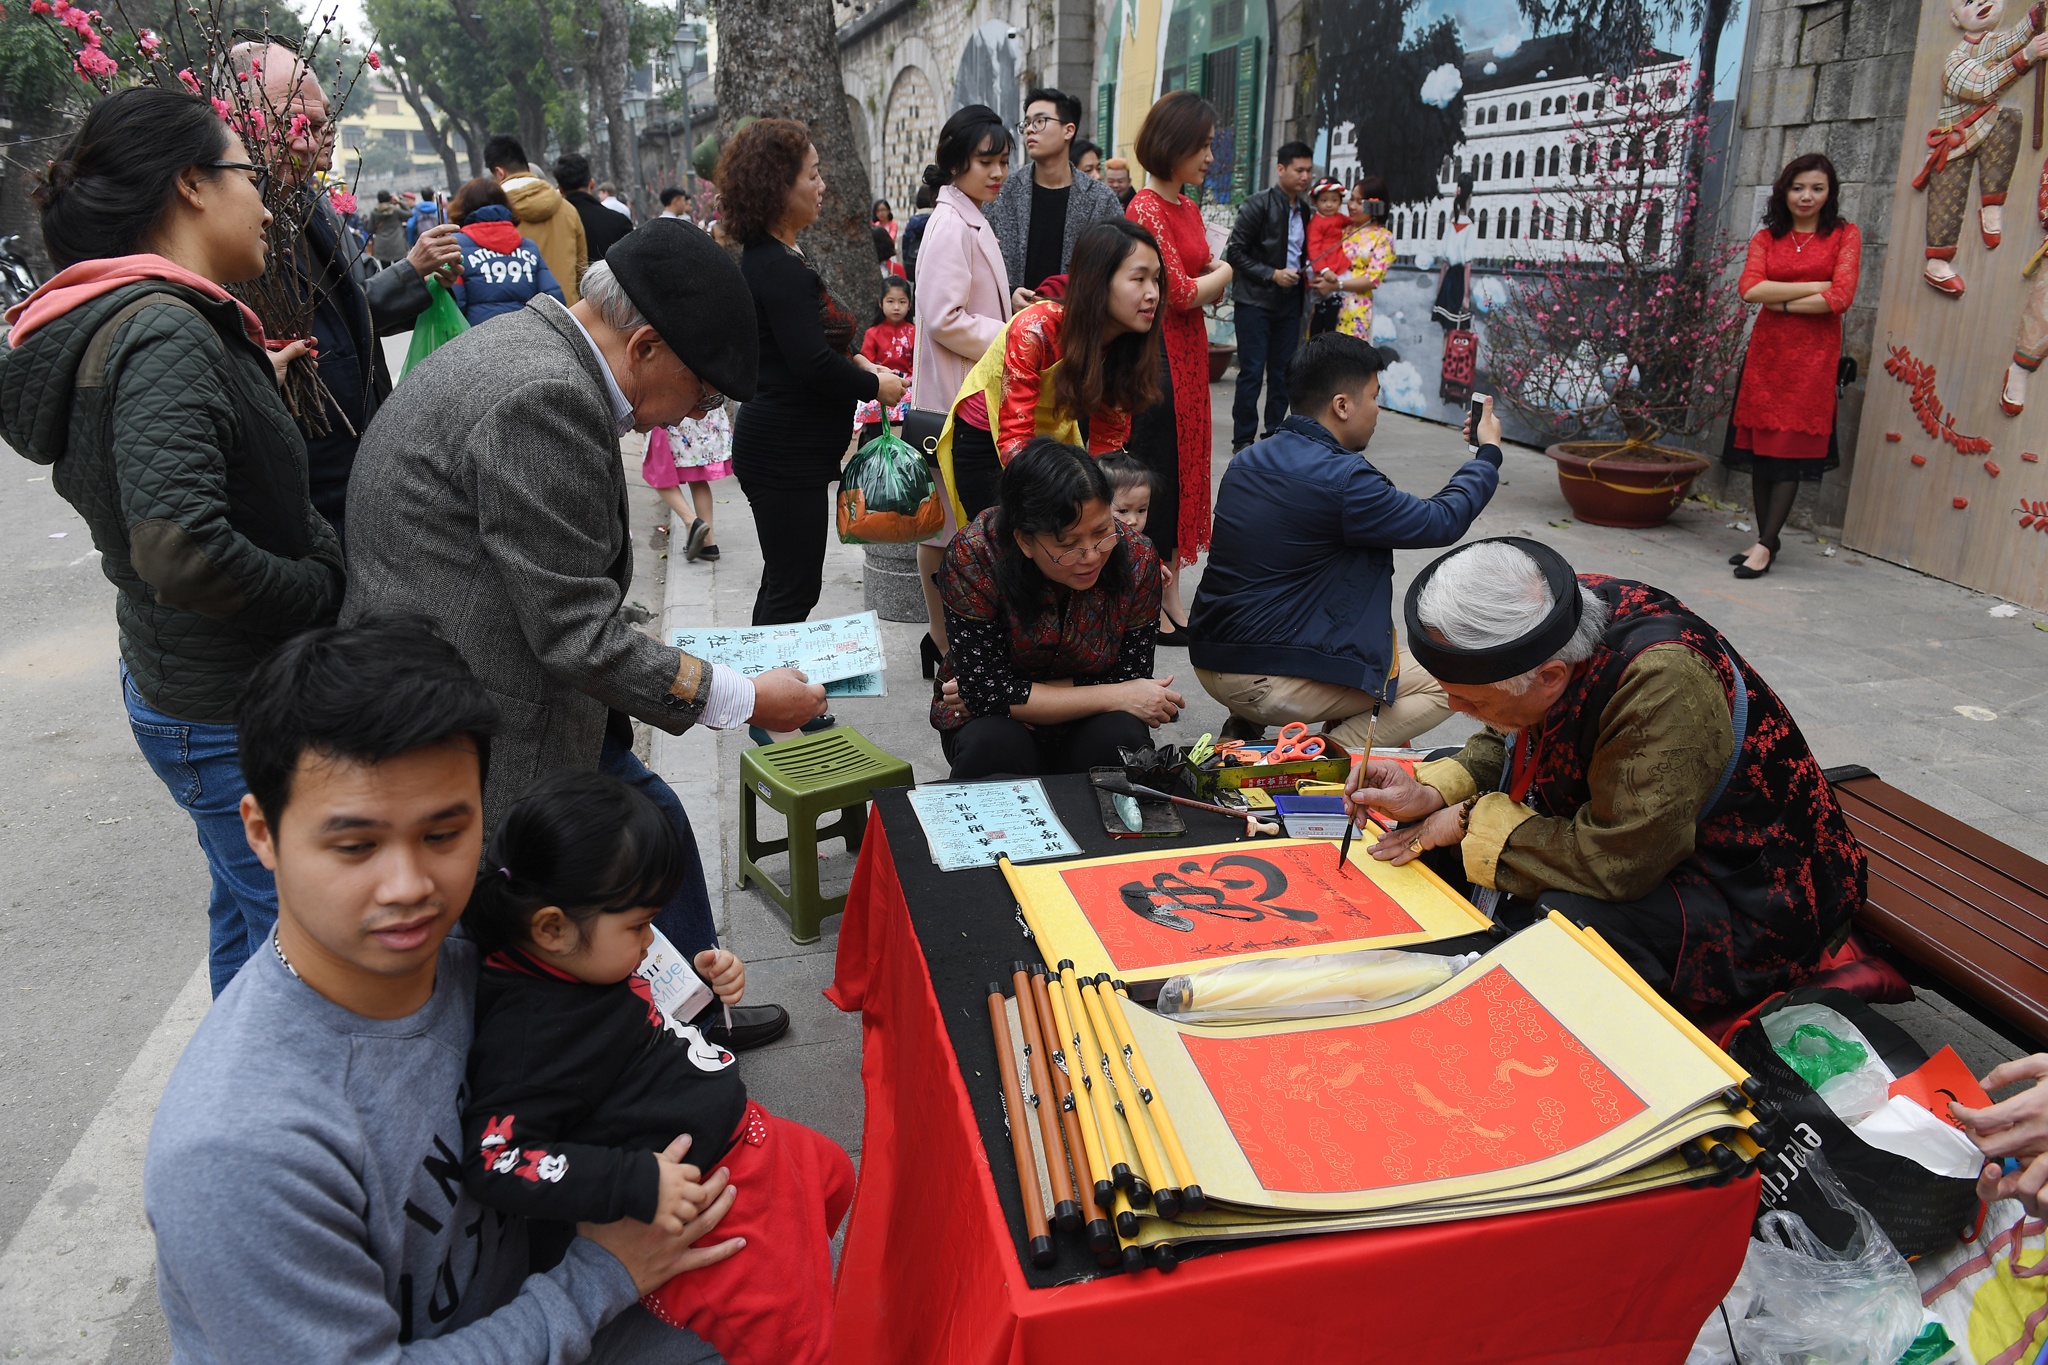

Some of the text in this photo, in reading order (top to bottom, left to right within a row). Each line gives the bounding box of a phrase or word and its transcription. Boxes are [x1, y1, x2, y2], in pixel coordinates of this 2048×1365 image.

[467, 247, 538, 267] ATHTICS
[480, 261, 533, 283] 1991
[651, 962, 683, 997] rue
[655, 971, 692, 1008] MILK
[1893, 1216, 1931, 1227] everrich
